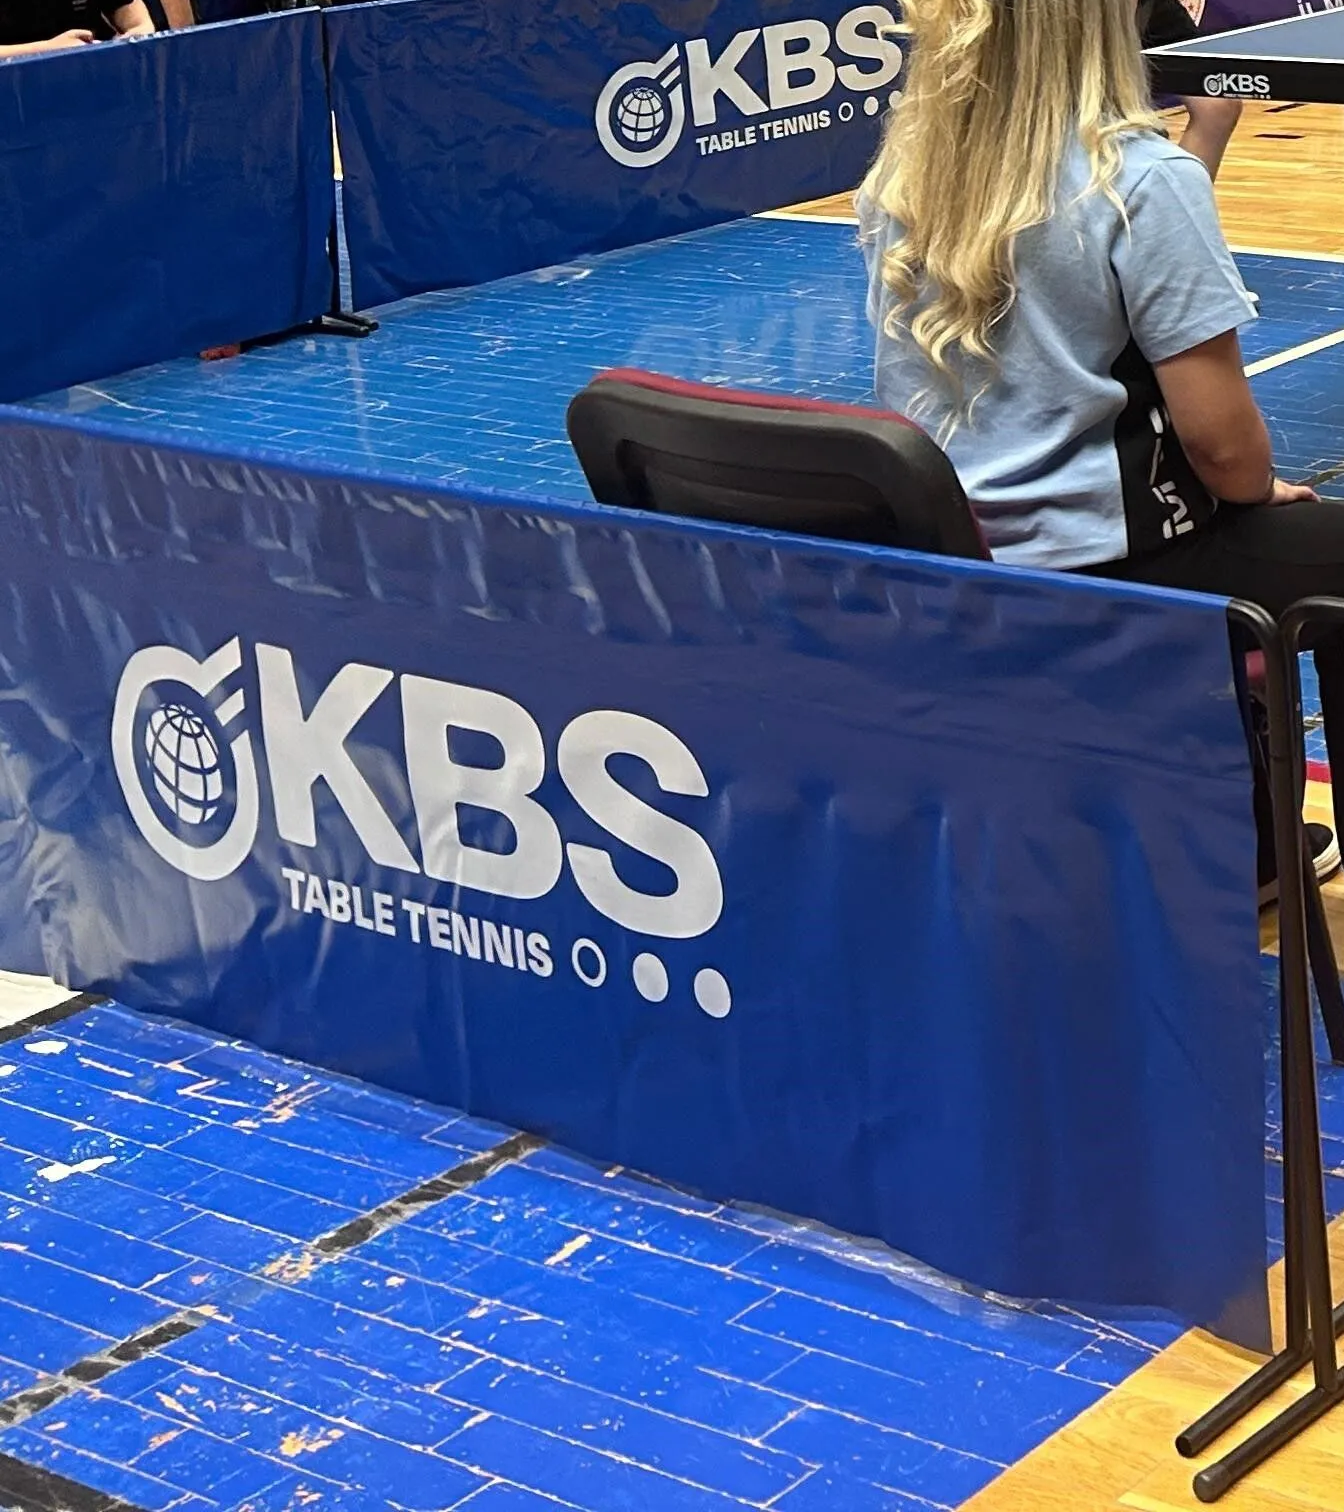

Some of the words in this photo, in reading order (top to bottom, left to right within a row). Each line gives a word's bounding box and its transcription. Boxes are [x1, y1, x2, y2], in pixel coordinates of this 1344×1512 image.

[685, 5, 903, 127] KBS
[1223, 72, 1270, 94] KBS
[696, 126, 757, 156] TABLE
[759, 109, 831, 141] TENNIS
[255, 642, 724, 940] KBS
[282, 867, 397, 937] TABLE
[401, 898, 554, 978] TENNIS
